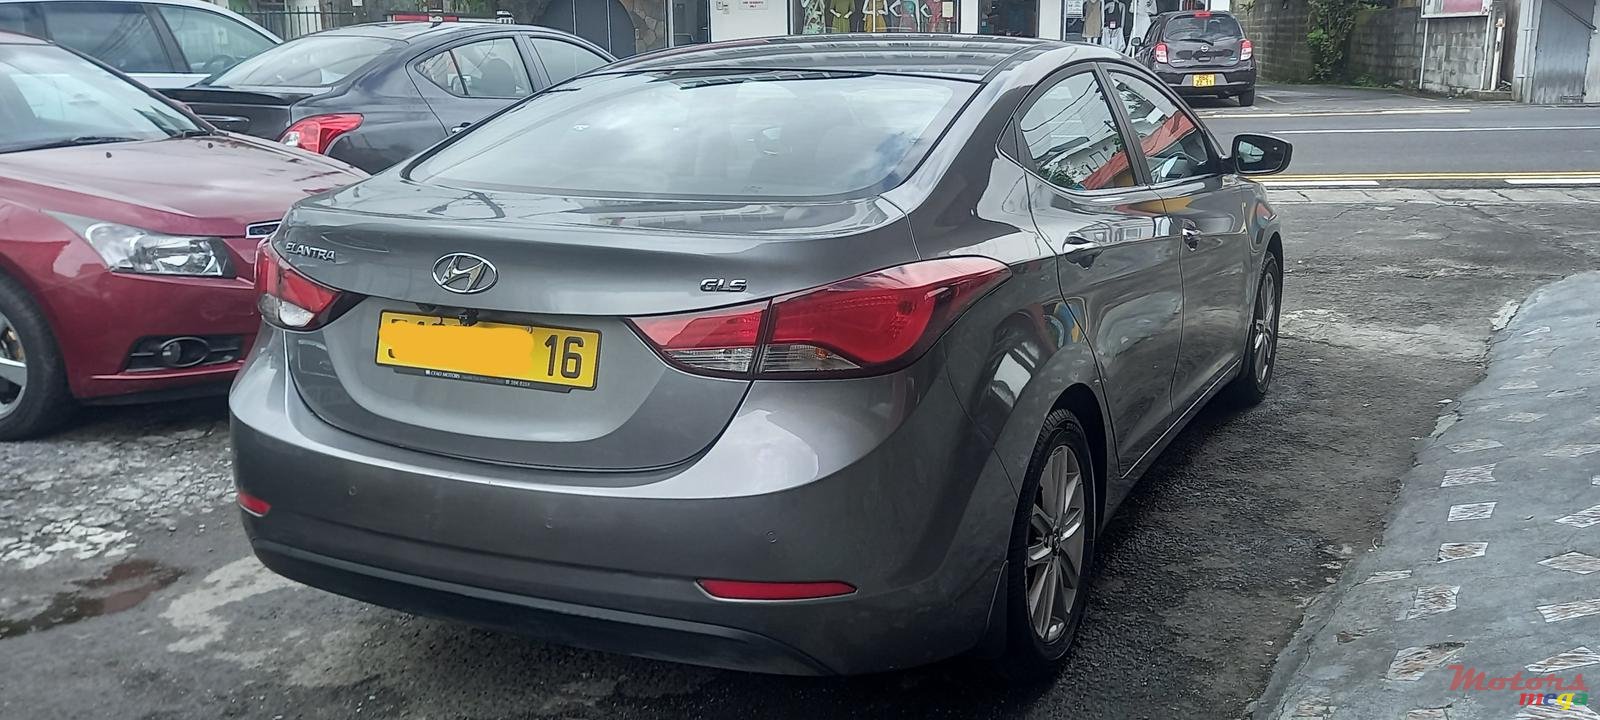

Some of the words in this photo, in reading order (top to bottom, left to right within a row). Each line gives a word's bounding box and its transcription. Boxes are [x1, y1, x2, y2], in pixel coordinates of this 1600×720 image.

[285, 242, 336, 262] ELANTRA
[700, 278, 747, 292] GLS
[544, 334, 584, 379] 16
